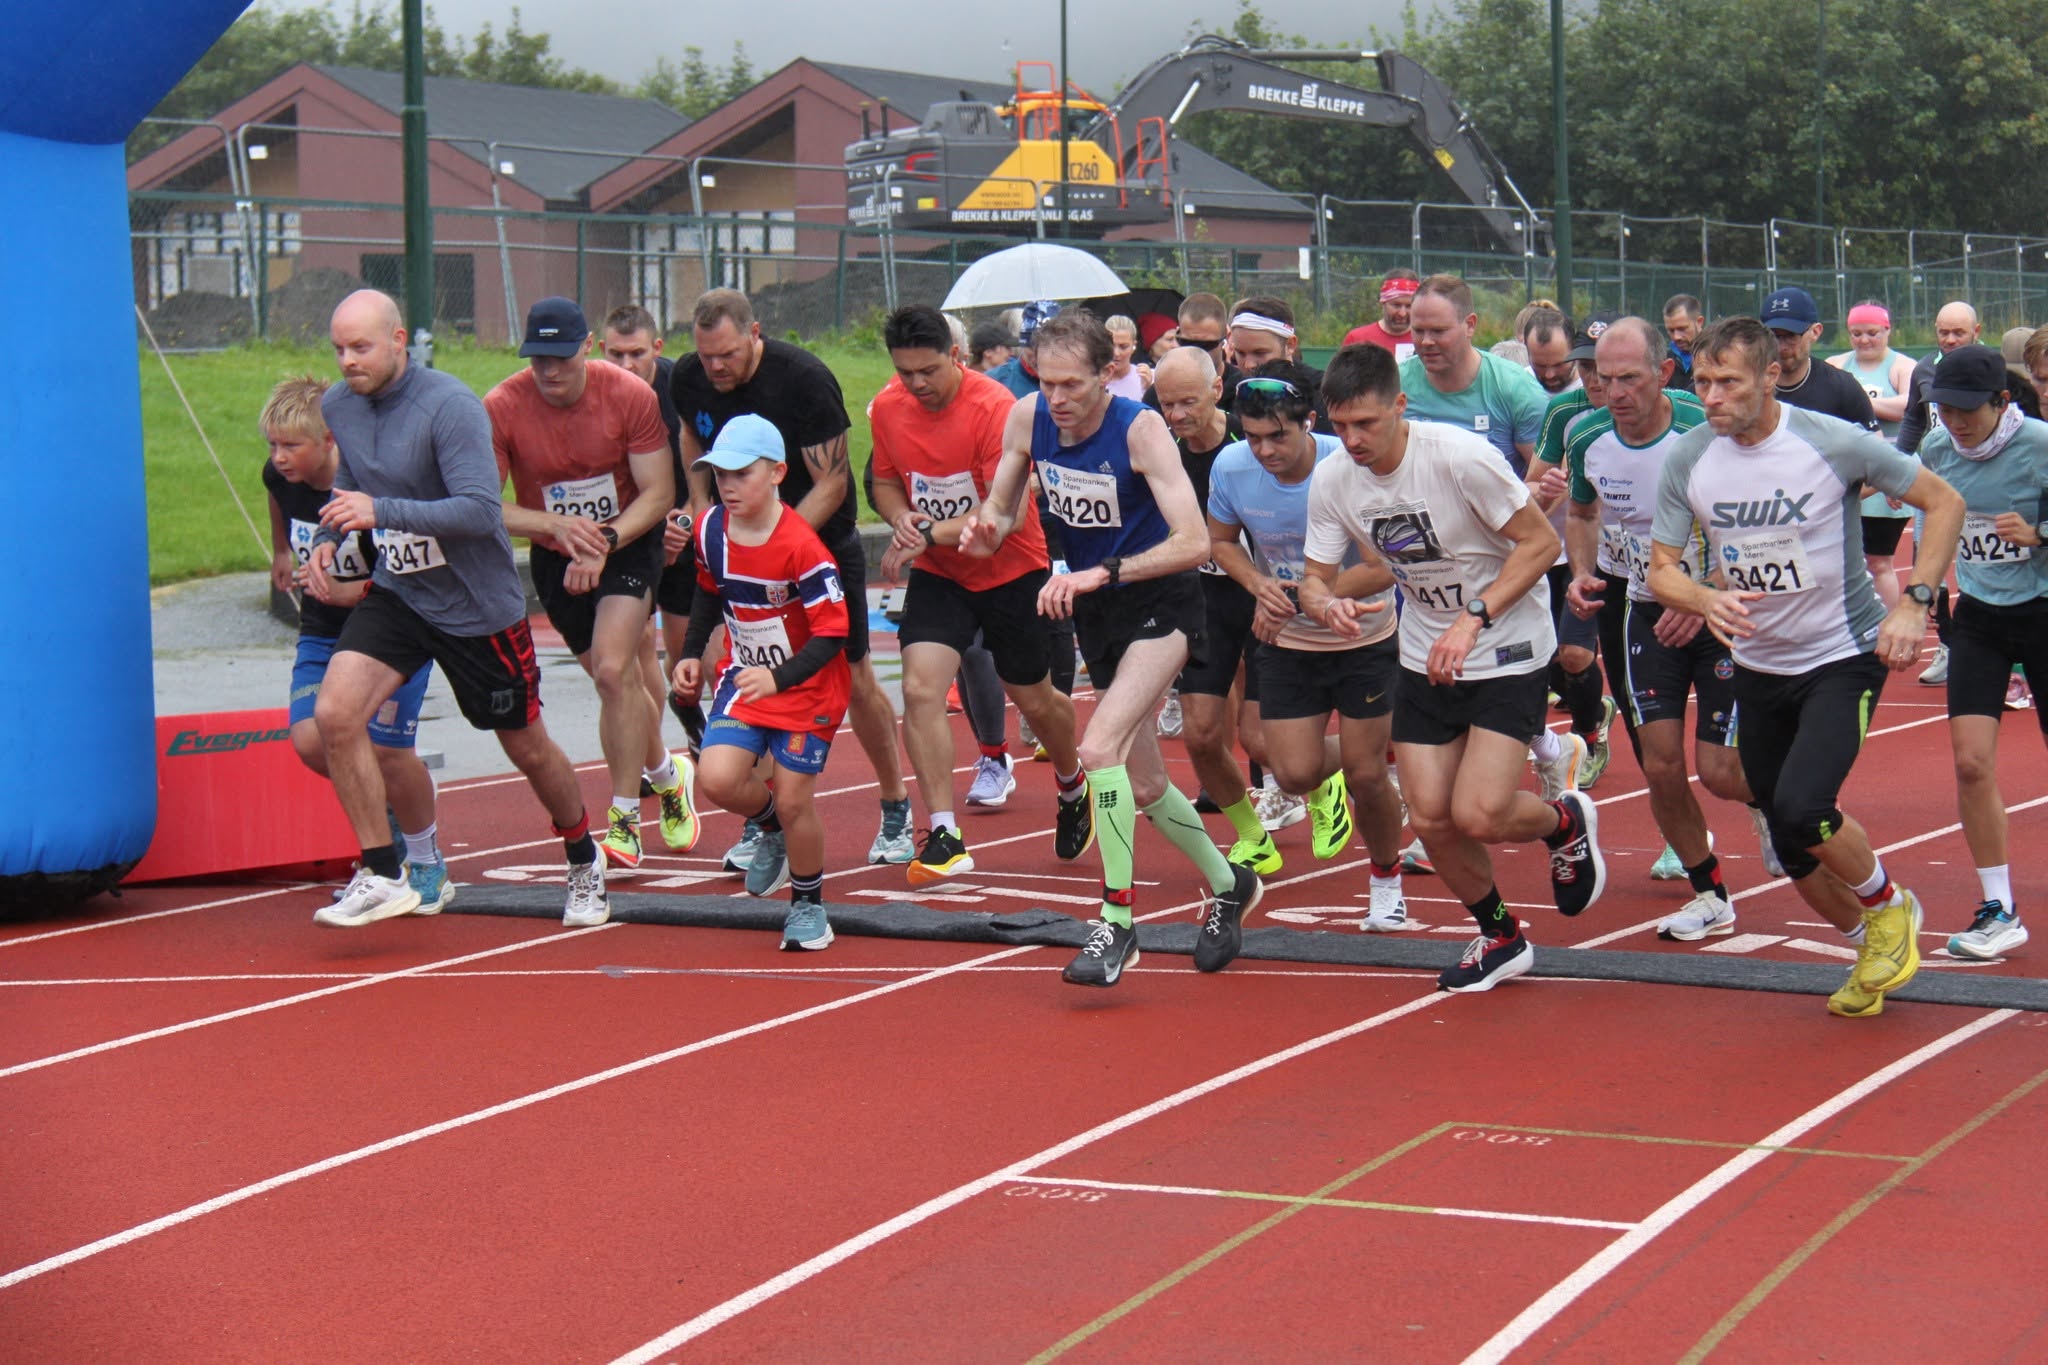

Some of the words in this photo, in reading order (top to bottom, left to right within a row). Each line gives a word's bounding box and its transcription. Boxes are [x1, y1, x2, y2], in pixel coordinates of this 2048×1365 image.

[1248, 84, 1299, 106] BREKKE
[1318, 96, 1365, 116] KLEPPE
[952, 209, 989, 222] BREKKE
[991, 210, 1000, 221] &
[1001, 209, 1037, 221] KLEPPE
[1080, 209, 1094, 221] AS
[1063, 473, 1110, 487] Sparebanken
[1063, 482, 1081, 491] Møre
[918, 496, 973, 521] 3322
[1049, 489, 1111, 524] 3420
[1603, 492, 1632, 501] TRIMTEX
[1741, 538, 1793, 551] Sparebanken
[1744, 551, 1765, 560] Møre
[1960, 532, 2021, 561] 3424
[1729, 560, 1801, 592] 3421
[735, 640, 787, 669] 3340
[166, 729, 290, 756] Eveque
